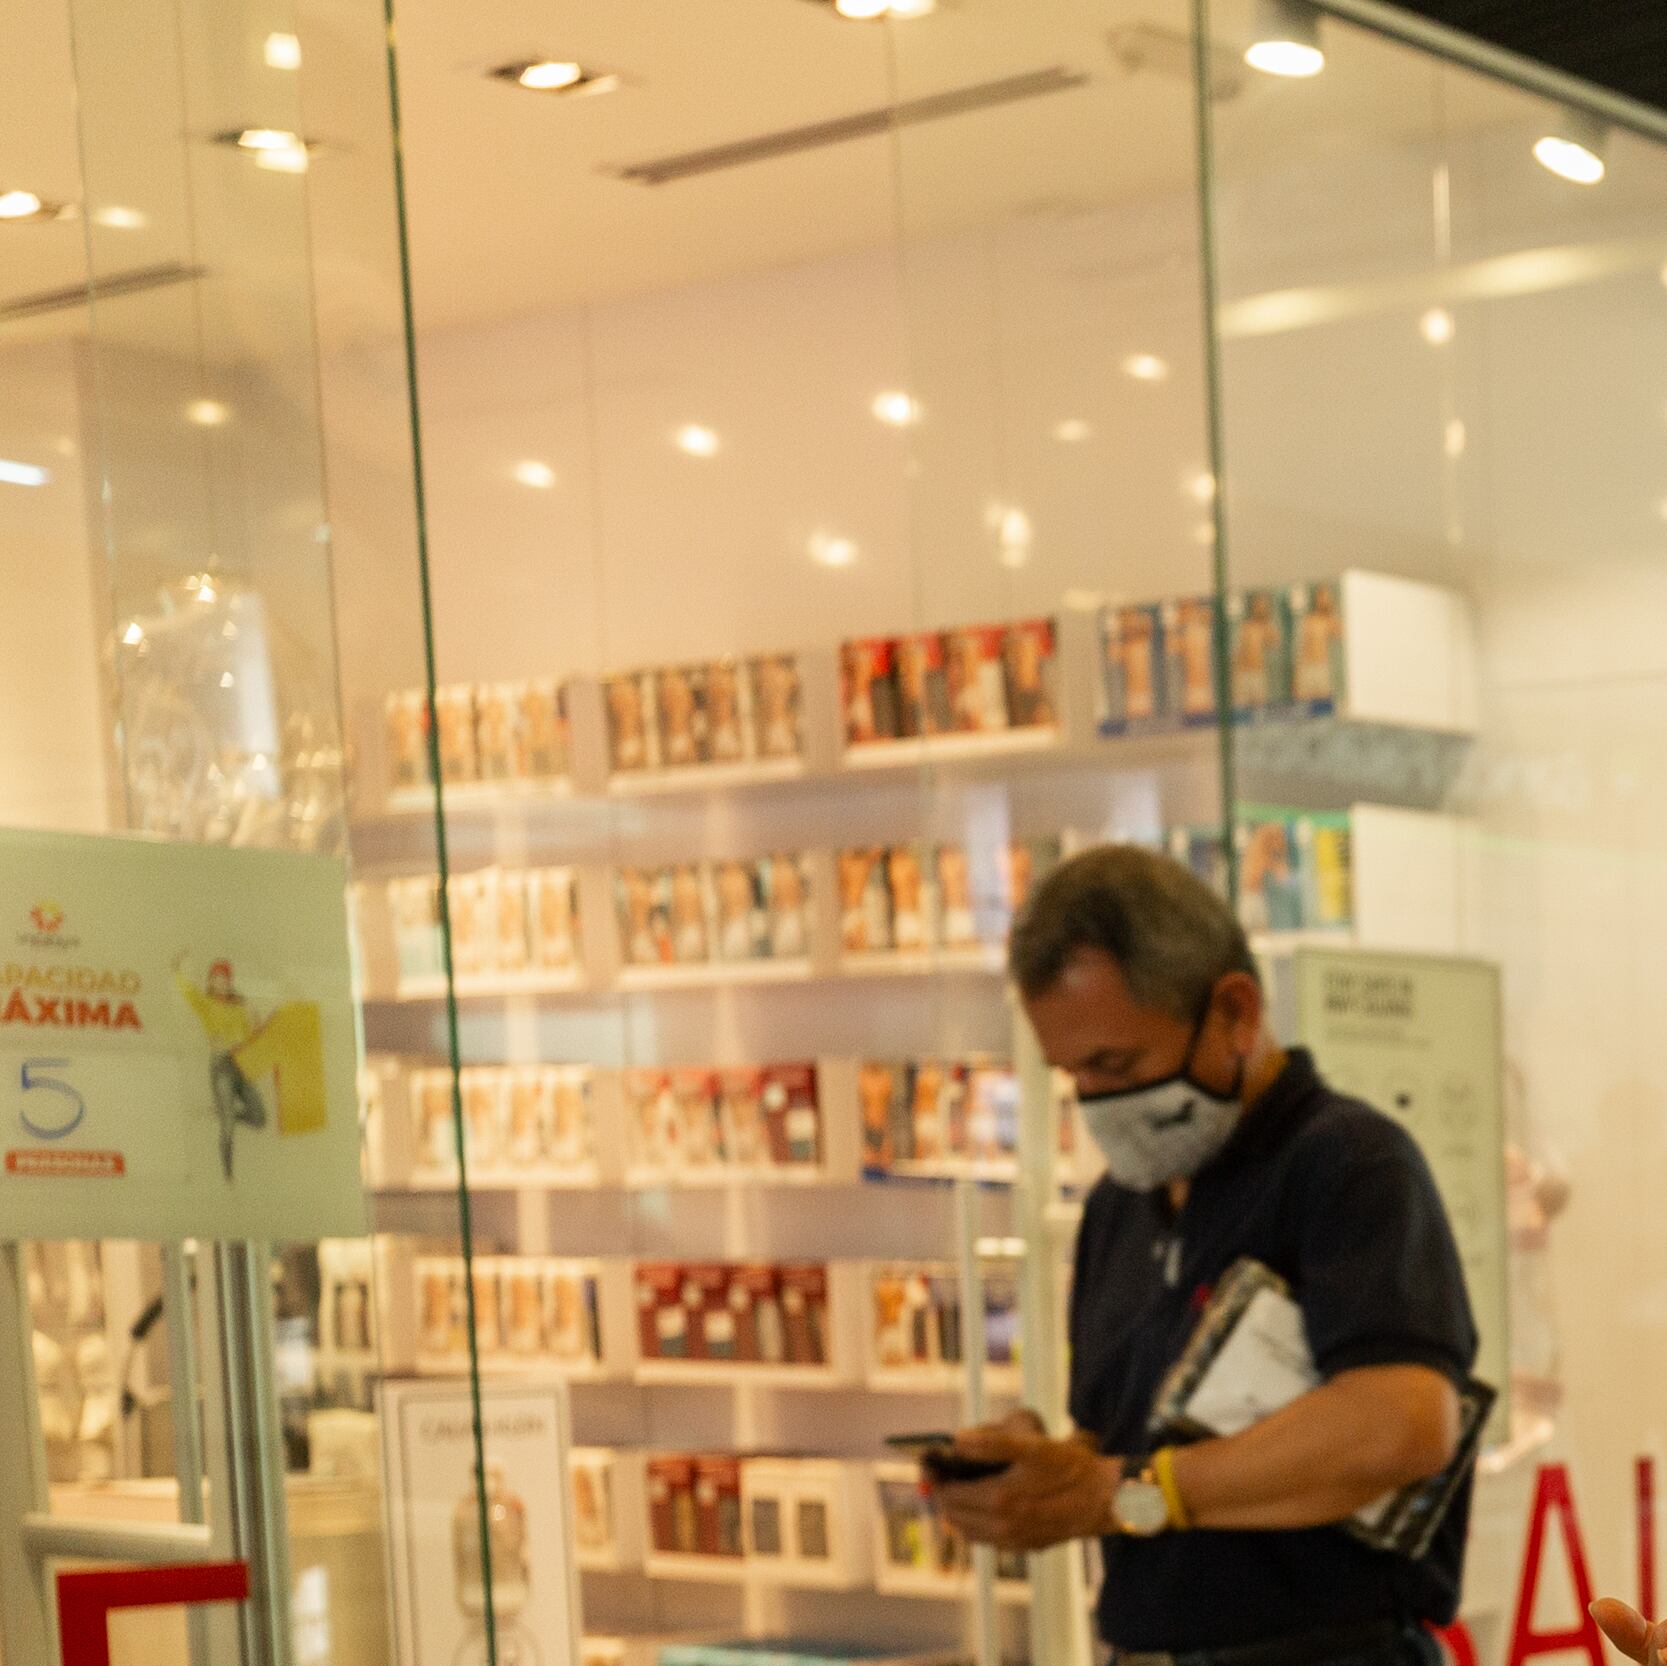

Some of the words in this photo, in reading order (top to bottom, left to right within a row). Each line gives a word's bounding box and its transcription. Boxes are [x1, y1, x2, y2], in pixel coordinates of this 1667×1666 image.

[0, 962, 143, 995] PACIDAD
[0, 987, 143, 1032] ÁXIMA
[19, 1056, 86, 1140] 5
